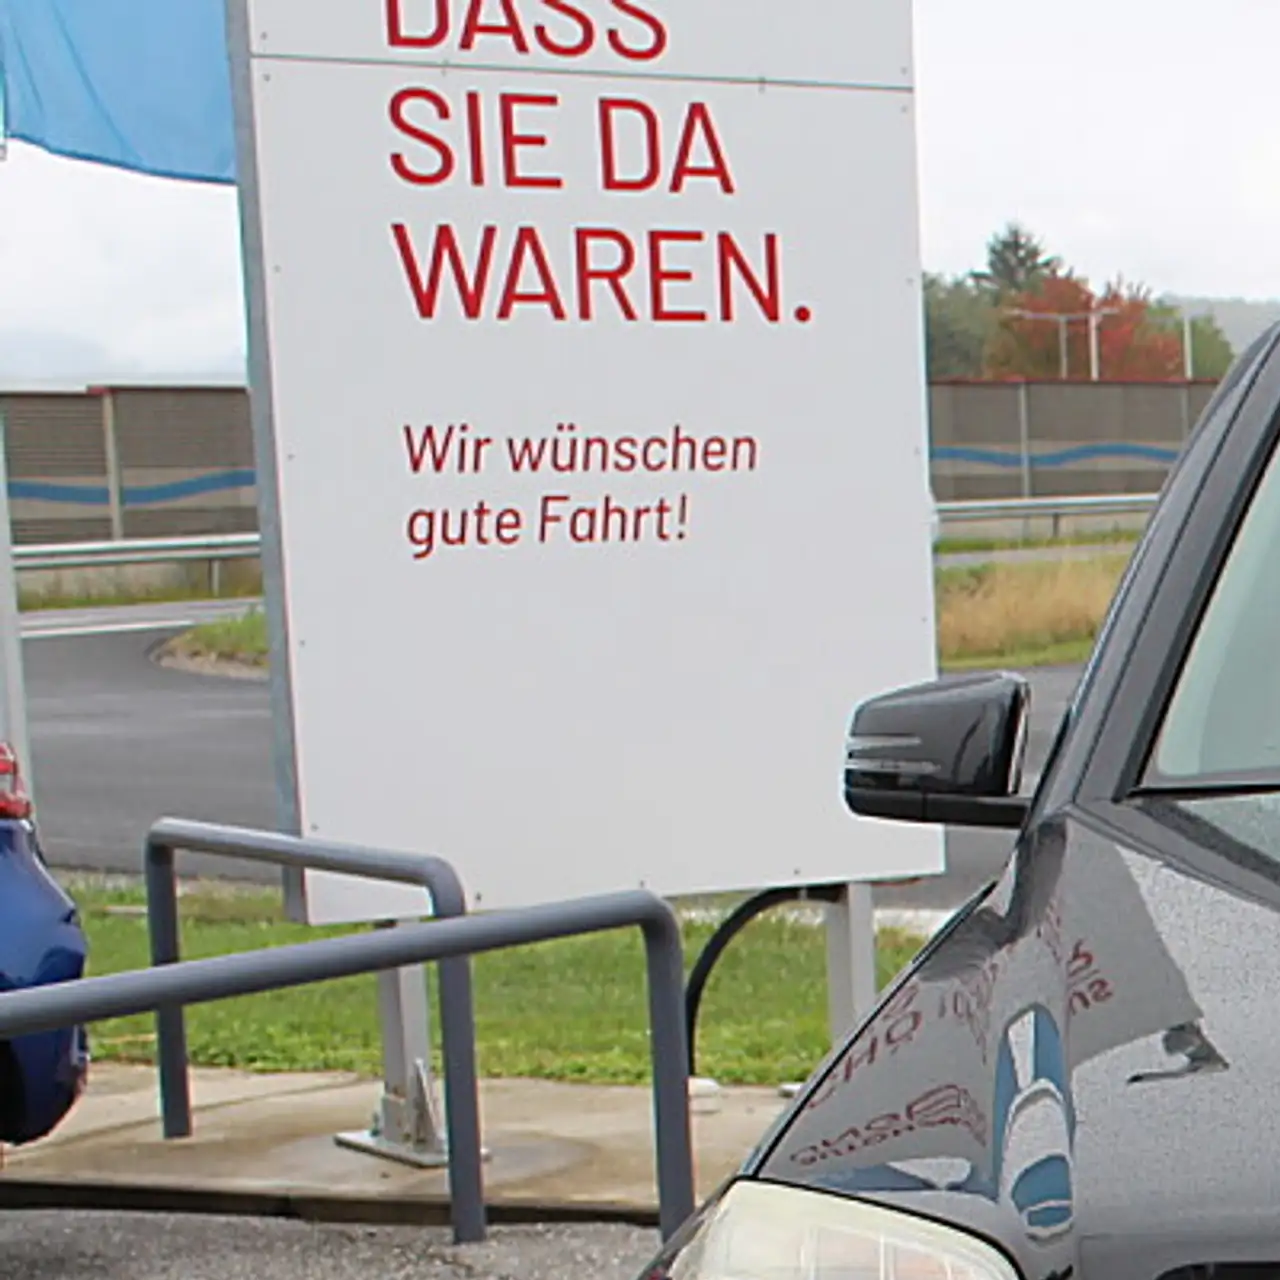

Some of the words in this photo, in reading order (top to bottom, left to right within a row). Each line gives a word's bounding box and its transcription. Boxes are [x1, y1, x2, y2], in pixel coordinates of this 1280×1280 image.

[388, 88, 563, 189] SIE
[598, 98, 735, 194] DA
[391, 223, 811, 323] WAREN.
[405, 424, 493, 472] Wir
[509, 424, 756, 472] wünschen
[409, 503, 521, 560] gute
[539, 495, 687, 542] Fahrt!
